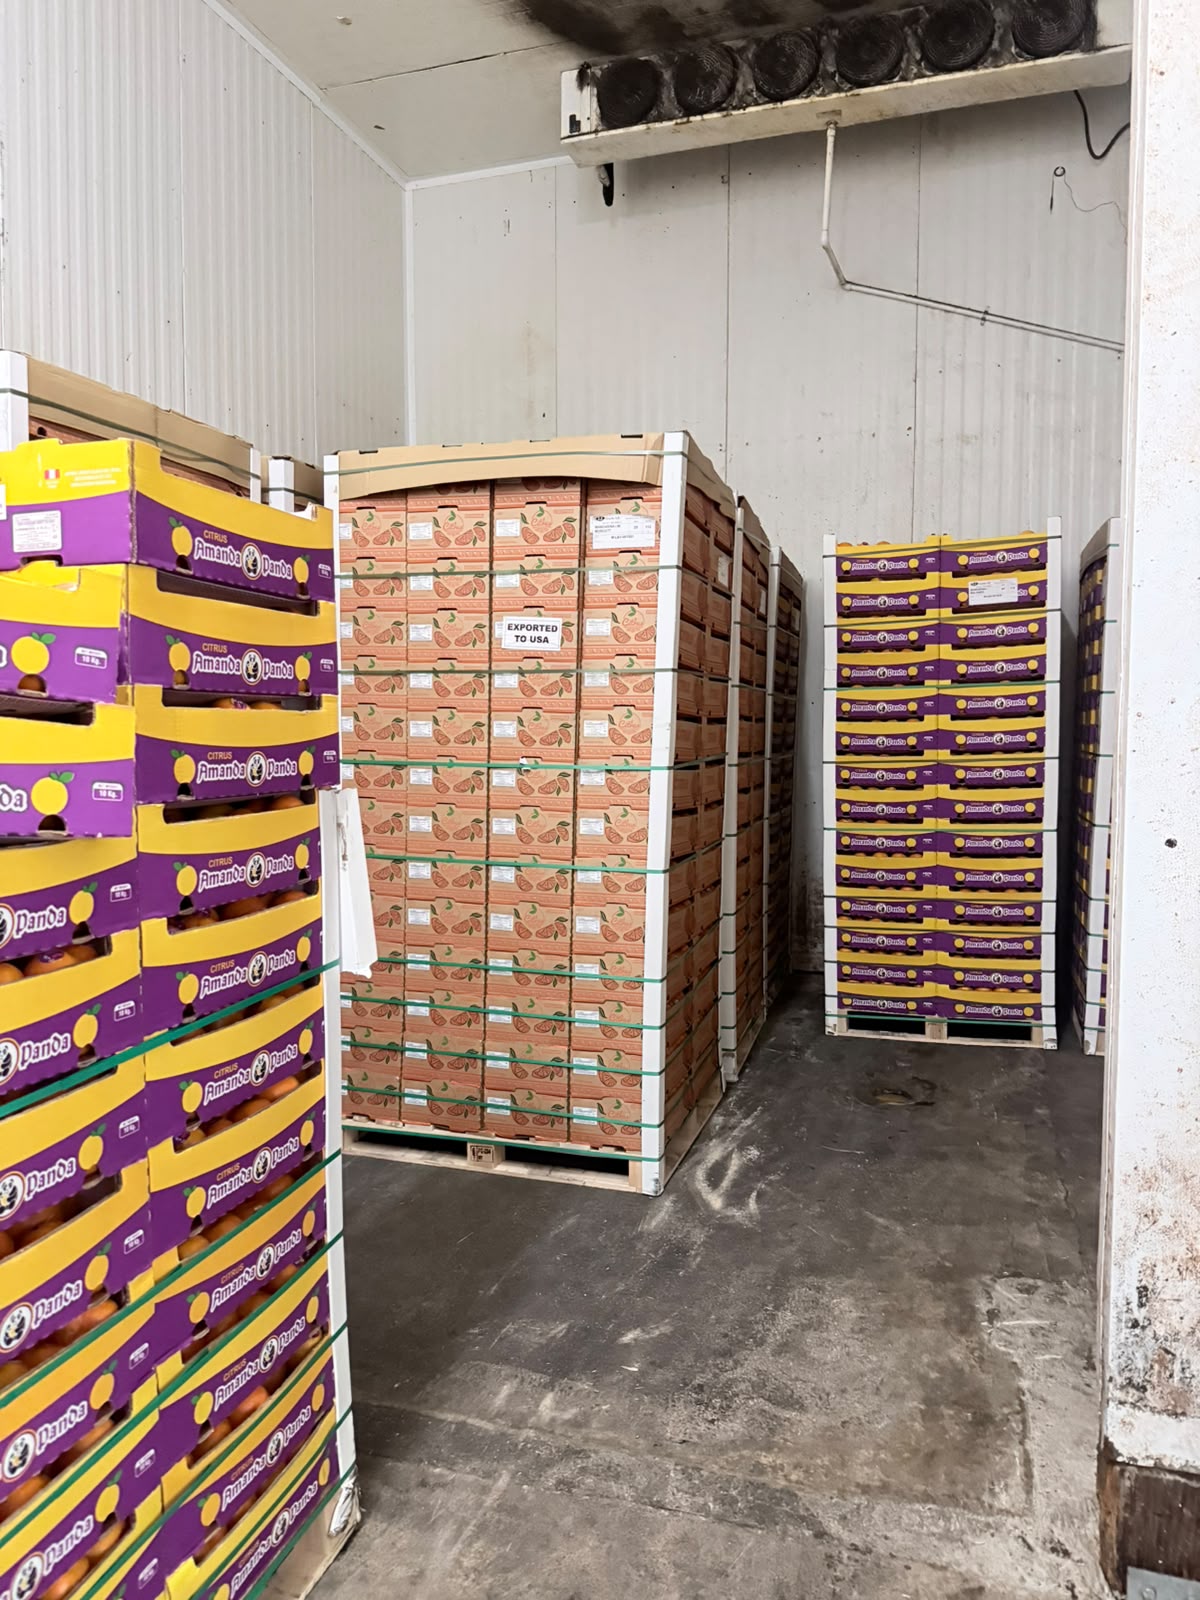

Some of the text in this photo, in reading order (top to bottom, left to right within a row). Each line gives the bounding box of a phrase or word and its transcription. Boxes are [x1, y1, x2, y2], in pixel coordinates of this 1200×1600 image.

[204, 530, 228, 544] CITRUS
[194, 537, 242, 567] Amanda
[262, 555, 293, 579] Panda
[507, 623, 558, 633] EXPORTED
[514, 635, 549, 644] TO USA
[192, 651, 293, 680] Amanda Panda
[202, 643, 228, 653] CITRUS
[196, 758, 297, 784] Amanda Panda
[207, 751, 232, 760] CITRUS
[198, 854, 294, 893] Amanda Panda
[208, 857, 232, 868] CITRUS
[13, 905, 67, 939] Panda
[199, 949, 296, 999] Amanda Panda
[210, 960, 235, 973] CITRUS
[19, 1032, 71, 1071] Panda
[214, 1063, 238, 1079] CITRUS
[203, 1044, 297, 1106] Amanda Panda
[25, 1157, 77, 1201] Panda
[207, 1136, 300, 1209] Amanda Panda
[216, 1163, 240, 1181] CITRUS
[210, 1229, 302, 1313] Amanda Panda
[32, 1279, 83, 1330] Panda
[214, 1316, 306, 1412] Amanda Panda
[36, 1400, 88, 1455] Panda
[221, 1454, 267, 1512] Amanda
[283, 1405, 311, 1447] Panda
[43, 1514, 94, 1576] Panda
